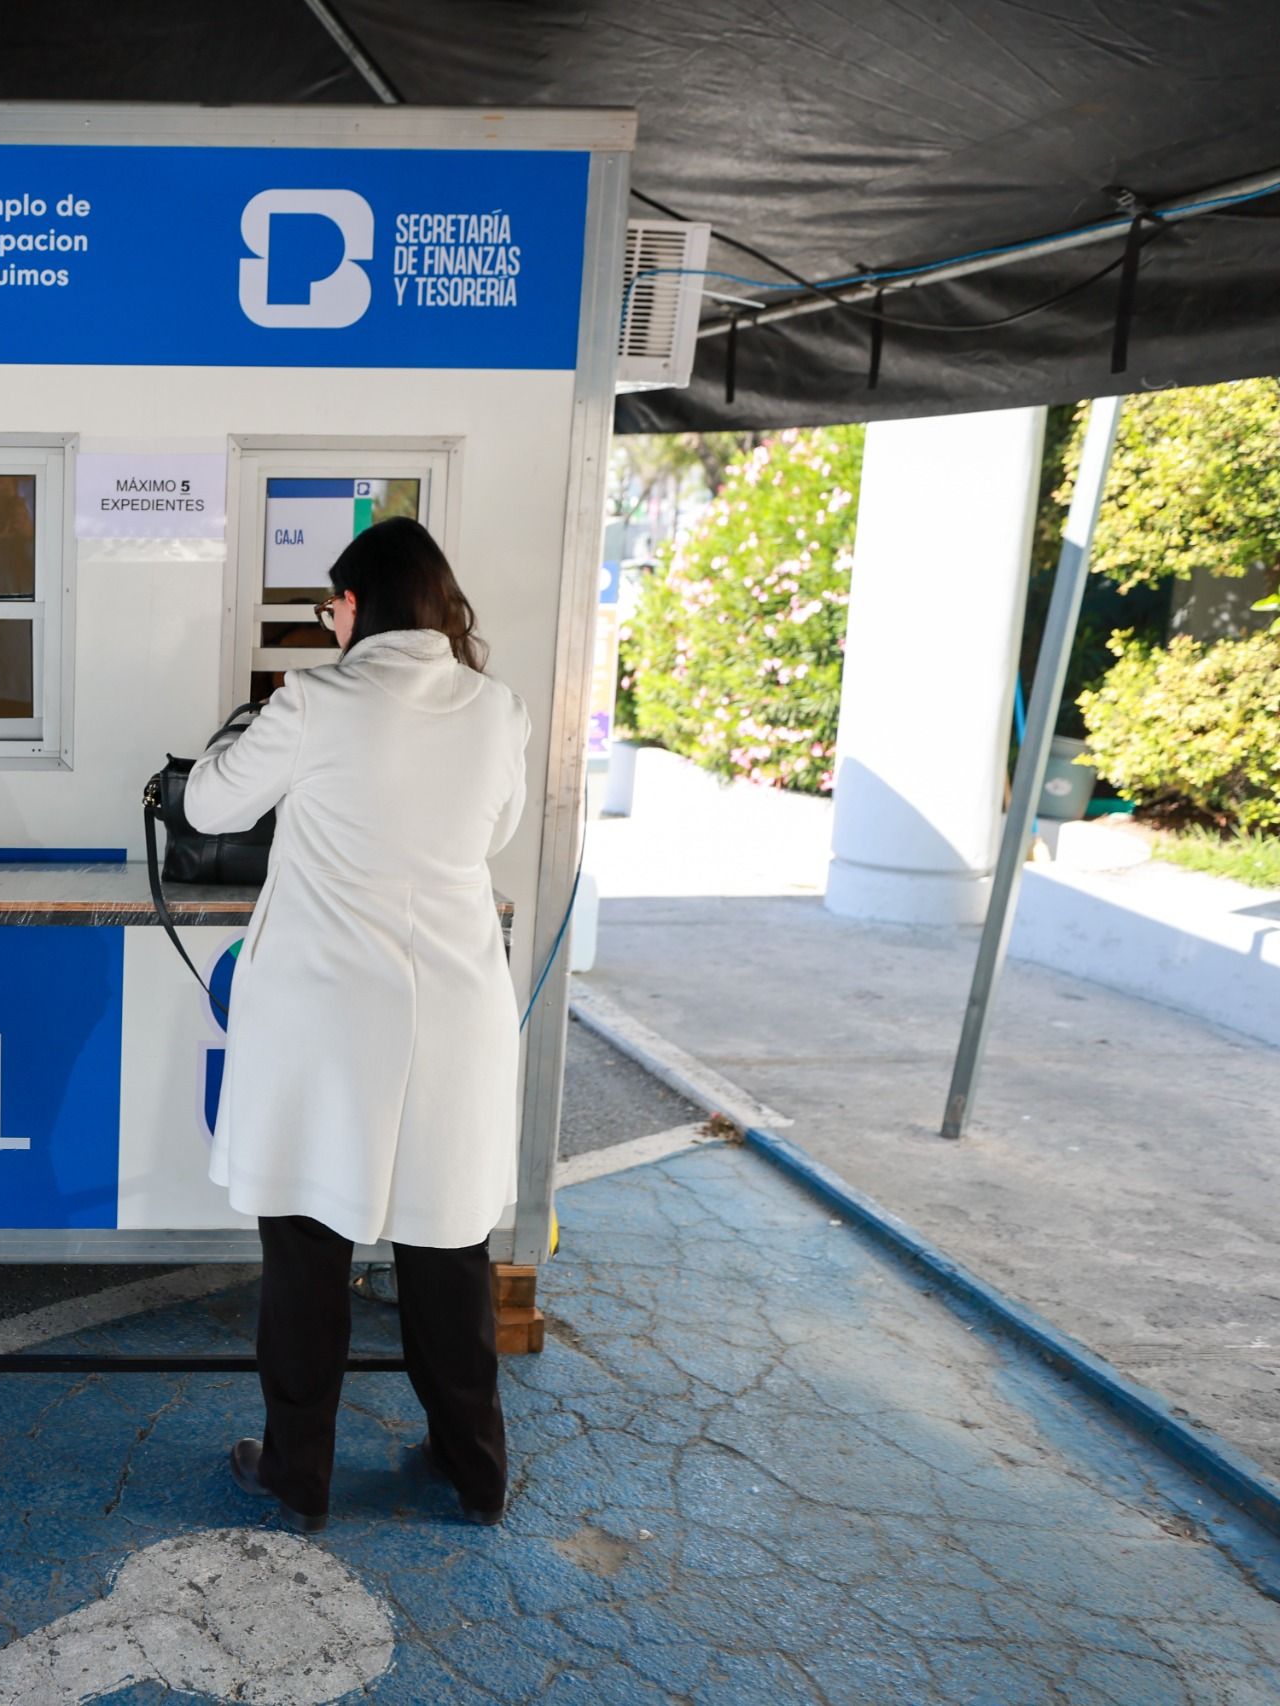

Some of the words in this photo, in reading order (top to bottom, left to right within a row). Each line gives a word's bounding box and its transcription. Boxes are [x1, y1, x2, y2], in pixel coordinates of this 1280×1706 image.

[55, 193, 91, 217] de
[395, 209, 511, 244] SECRETARÍA
[393, 245, 419, 275] DE
[423, 245, 521, 276] FINANZAS
[394, 277, 409, 306] Y
[414, 273, 517, 307] TESORERÍA
[116, 476, 177, 493] MÁXIMO
[181, 480, 191, 493] 5
[100, 498, 205, 512] EXPEDIENTES
[274, 528, 304, 545] CAJA
